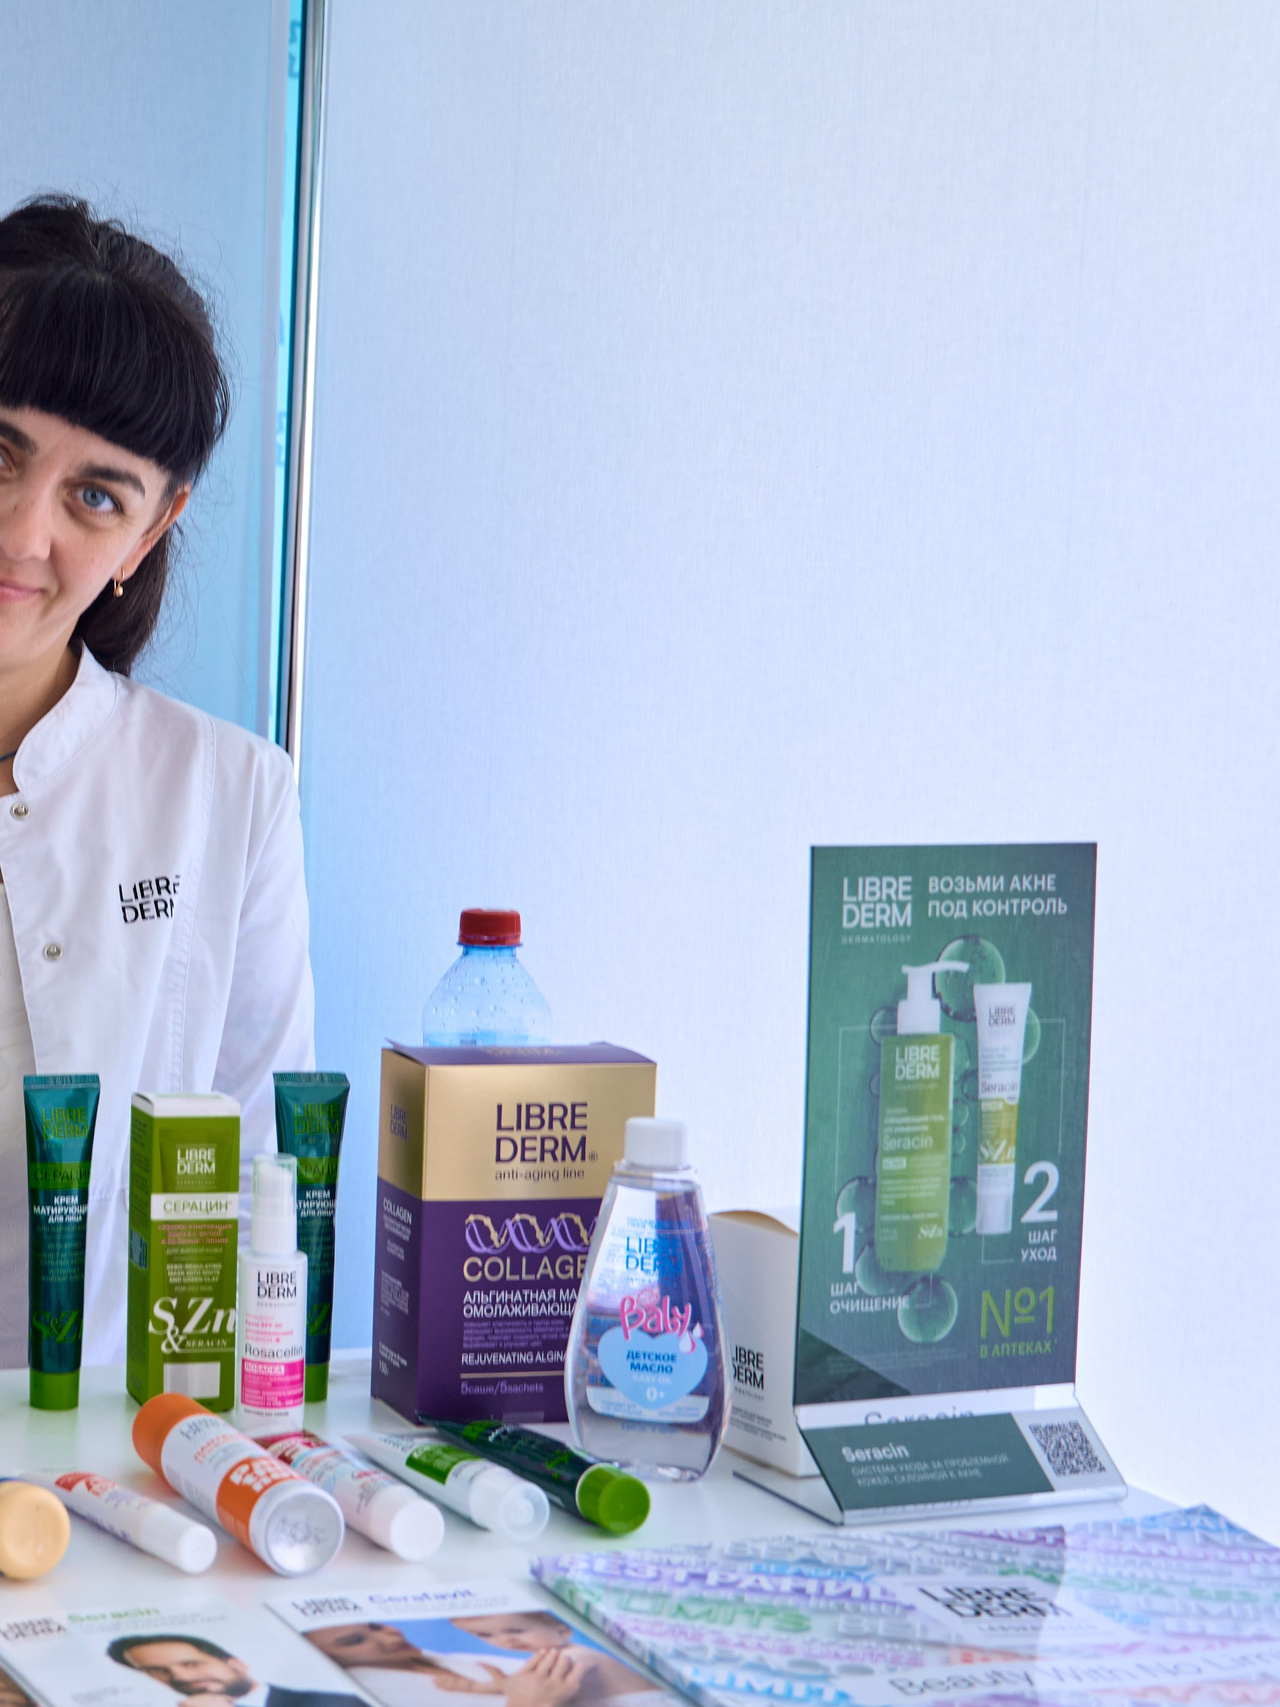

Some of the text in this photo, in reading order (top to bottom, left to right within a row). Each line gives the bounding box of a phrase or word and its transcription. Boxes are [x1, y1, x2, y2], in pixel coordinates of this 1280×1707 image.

[842, 876, 912, 903] LIBRE
[928, 873, 1057, 894] ВОЗЬМИ АКНЕ
[842, 902, 912, 929] DERM
[927, 897, 1068, 919] ПОД КОНТРОЛЬ
[988, 1016, 1016, 1027] DERM
[895, 1044, 940, 1063] LIBRE
[895, 1062, 940, 1081] DERM
[41, 1106, 87, 1124] LIBRE
[294, 1103, 339, 1119] LIBRE
[389, 1103, 408, 1122] LIBRE
[496, 1102, 588, 1132] LIBRE
[42, 1120, 88, 1140] DERM
[294, 1119, 340, 1135] DERM
[389, 1119, 409, 1141] DERM
[882, 1134, 933, 1152] Seracin
[176, 1147, 216, 1161] LIBRE
[33, 1168, 91, 1184] СЕРАЦИ
[176, 1160, 216, 1175] DERM
[494, 1167, 585, 1183] anti-aging line
[53, 1194, 79, 1206] КРЕМ
[305, 1189, 331, 1200] КРЕМ
[1021, 1160, 1059, 1223] 2
[163, 1200, 229, 1215] СЕРАЦИН
[383, 1197, 412, 1225] COLLAGEN
[833, 1211, 856, 1274] 1
[1028, 1229, 1057, 1245] ШАГ
[1020, 1247, 1057, 1262] УХОД
[257, 1270, 297, 1285] LIBRE
[463, 1256, 587, 1283] COLLAGE
[257, 1284, 297, 1299] DERM
[463, 1288, 579, 1304] АЛЬГИНАТНАЯ МА
[830, 1281, 859, 1297] ШАГ
[463, 1302, 576, 1318] ОМОЛАЖИВАЮЩА
[829, 1294, 910, 1315] ОЧИЩЕНИЕ
[245, 1343, 303, 1360] Rosacellin
[461, 1351, 534, 1366] REJUVENATING
[626, 1349, 677, 1362] ДЕТСКОЕ
[732, 1345, 764, 1372] IBRE
[630, 1362, 673, 1374] МАСЛО
[646, 1386, 665, 1402] 0+
[841, 1443, 910, 1464] Seracin
[851, 1463, 897, 1476] СИСТЕМА
[944, 1453, 1010, 1469] ПРОБЛЕМНОЙ
[918, 1586, 1056, 1603] LIBRE
[944, 1601, 1072, 1618] DERM
[889, 1659, 1203, 1696] Beauty With No
